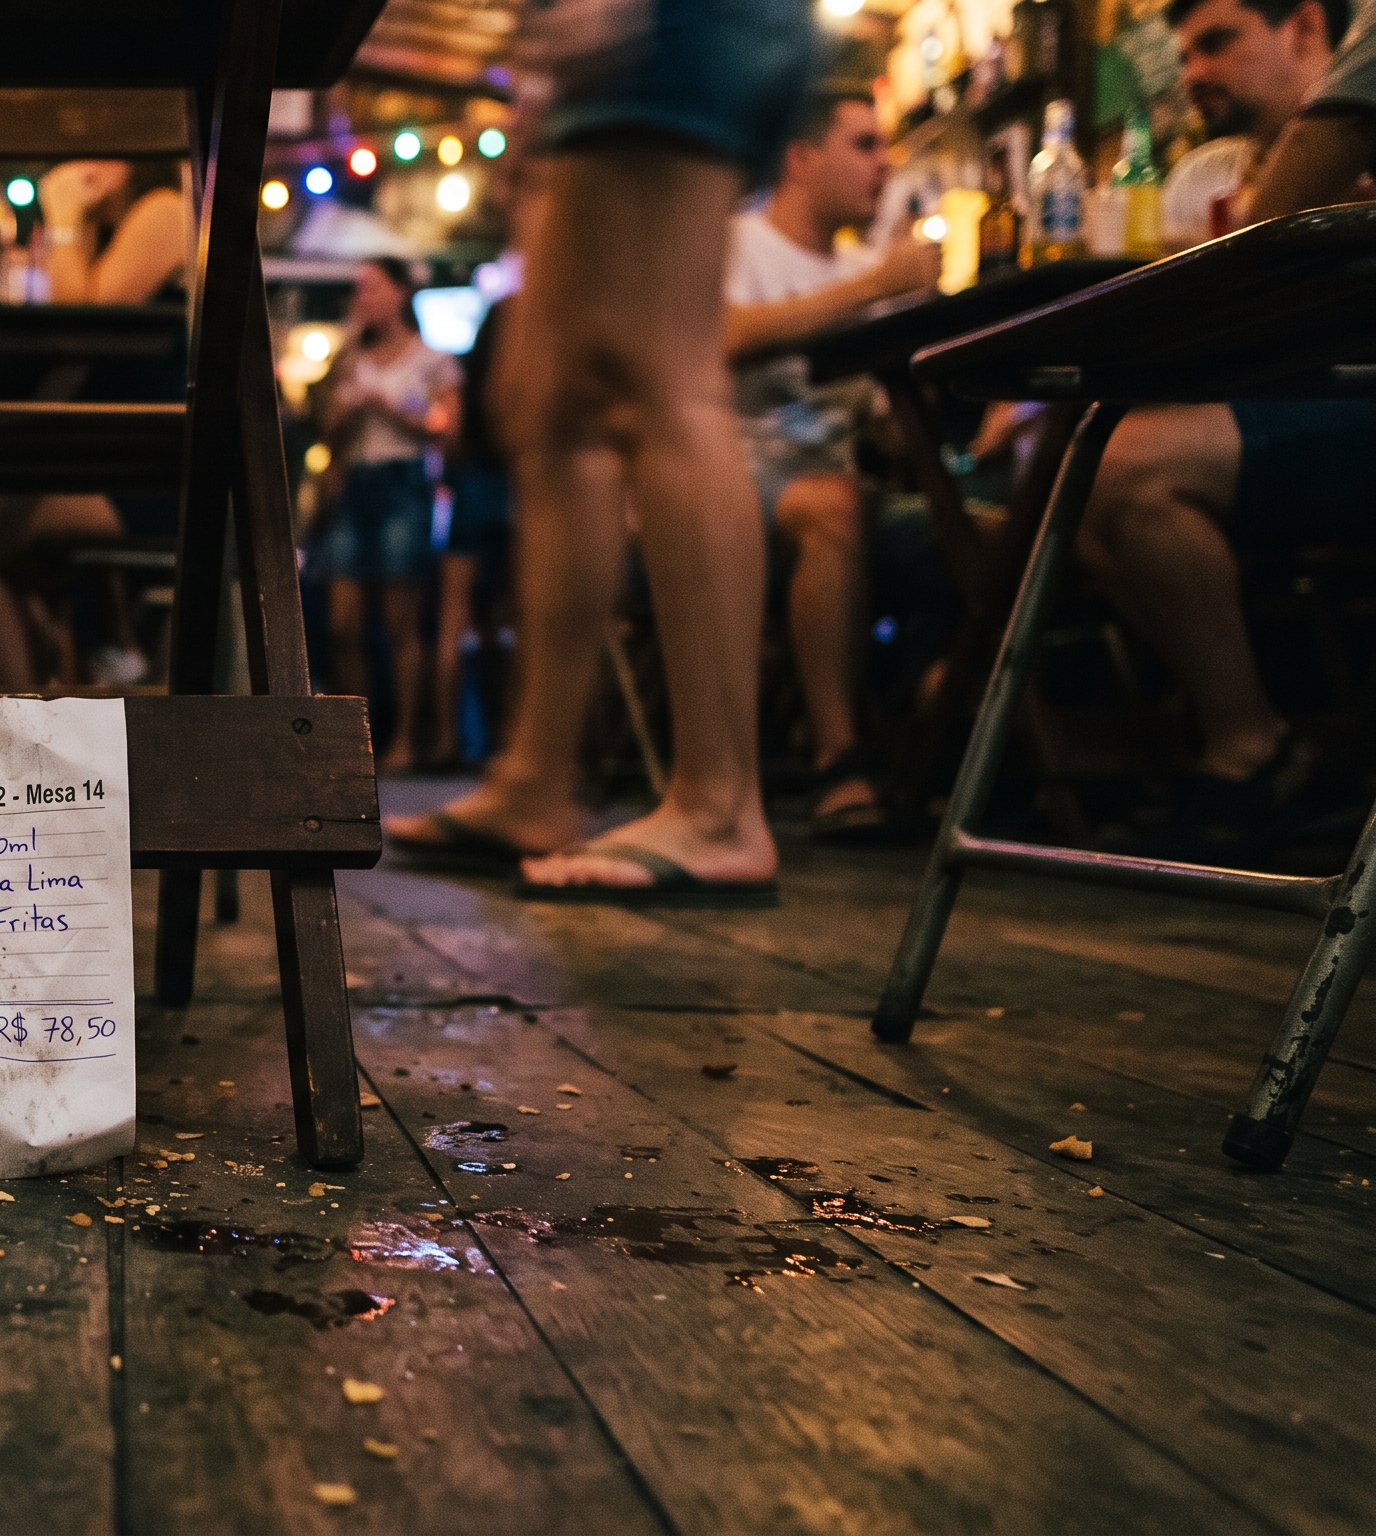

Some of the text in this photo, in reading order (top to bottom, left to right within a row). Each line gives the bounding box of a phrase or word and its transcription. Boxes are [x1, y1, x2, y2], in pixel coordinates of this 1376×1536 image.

[27, 783, 75, 804] Mesa
[83, 780, 104, 800] 14
[28, 864, 83, 891] Lima
[42, 1016, 115, 1046] 78,50
